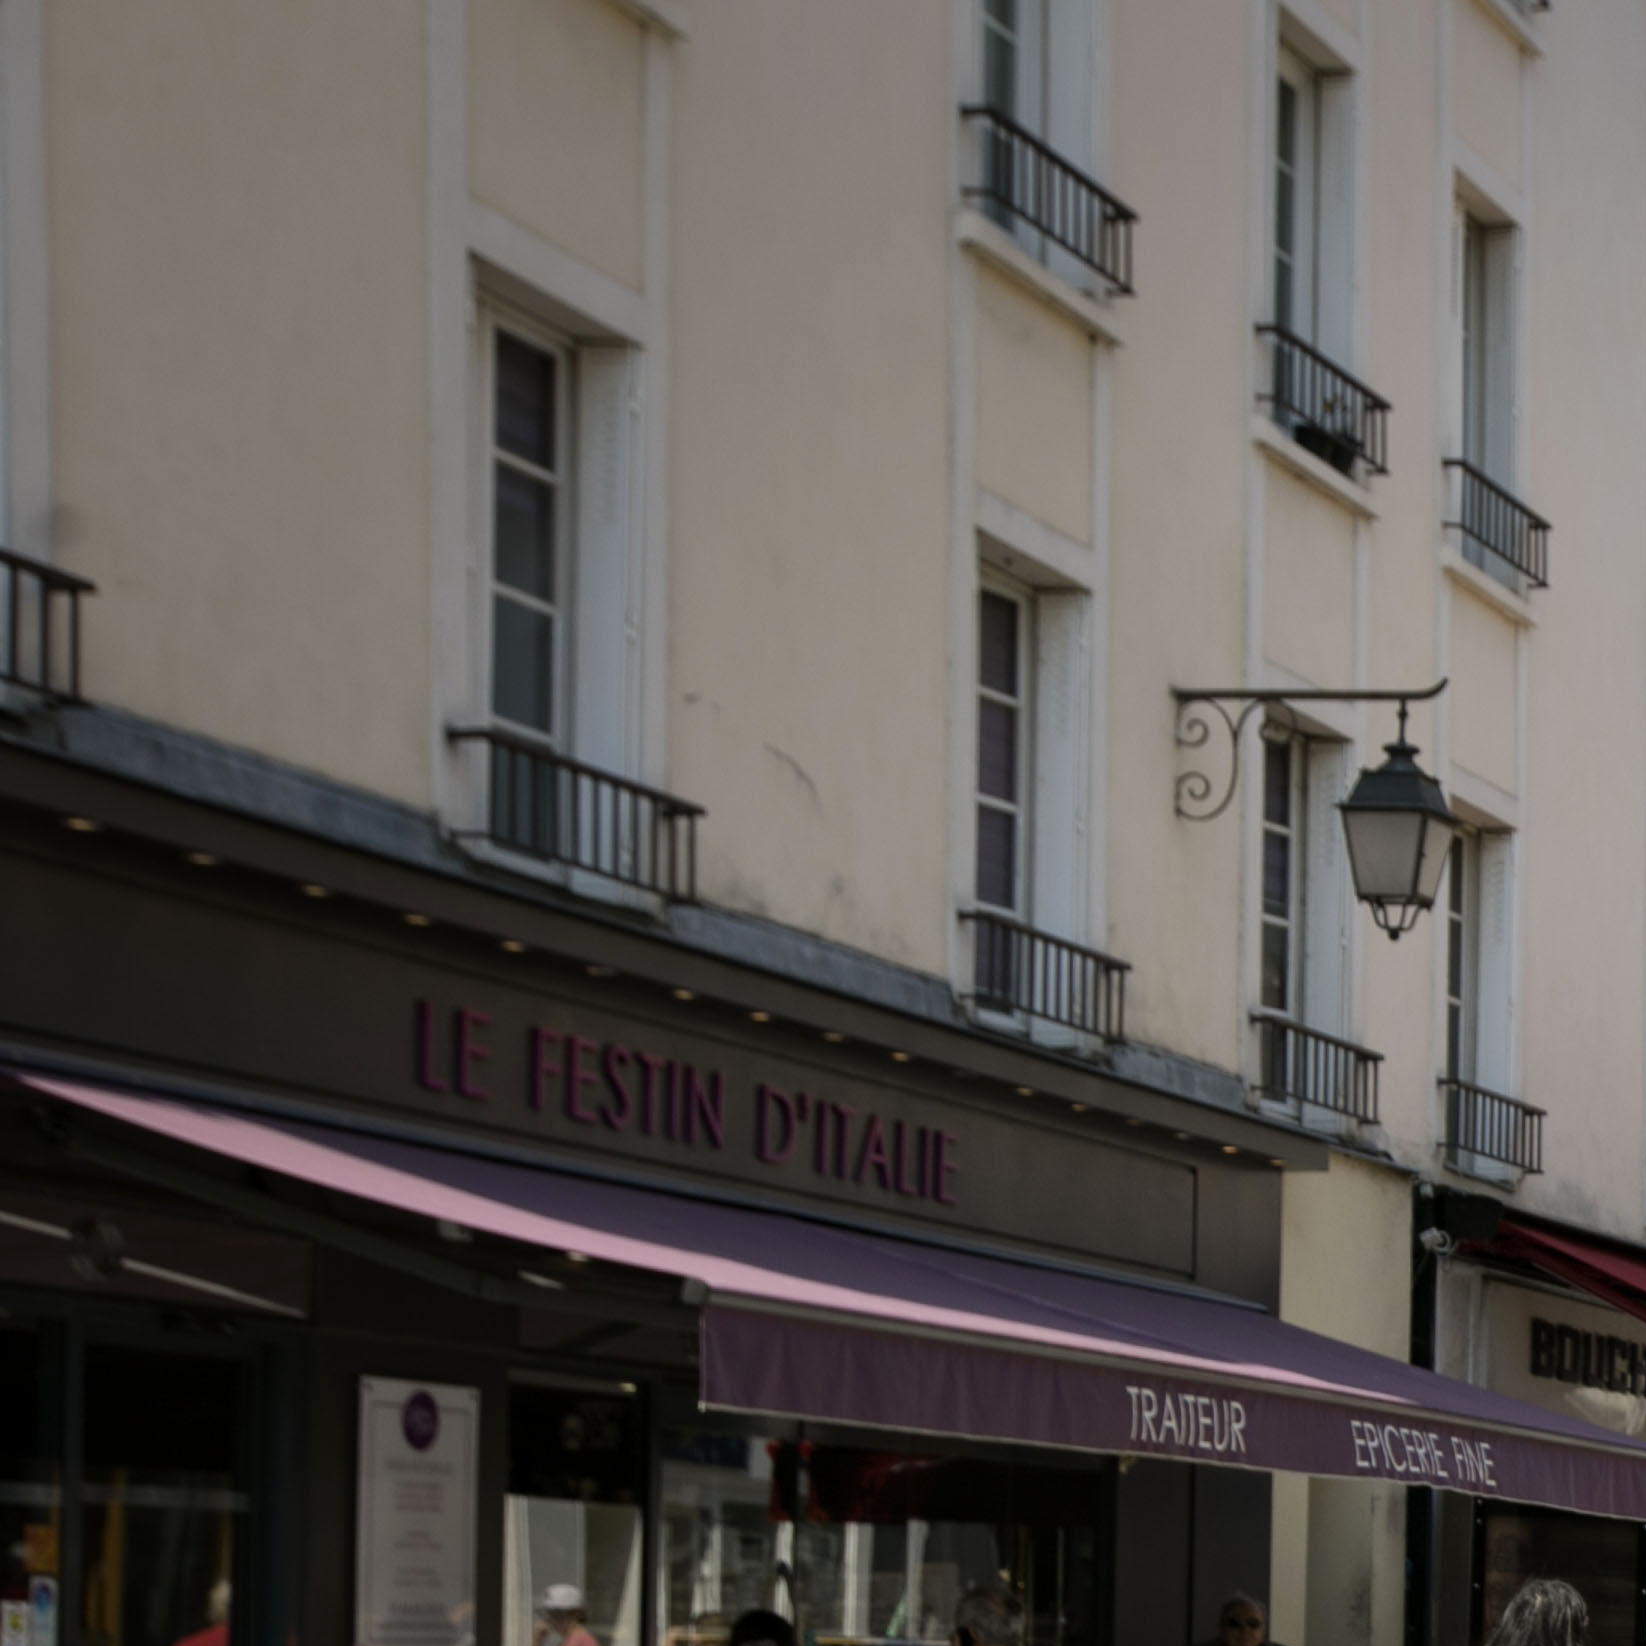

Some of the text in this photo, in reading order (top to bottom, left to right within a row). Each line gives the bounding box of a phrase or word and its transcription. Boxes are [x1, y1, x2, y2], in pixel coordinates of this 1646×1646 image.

[417, 1000, 960, 1206] LE FESTIN D'ITALIE
[1126, 1386, 1497, 1486] TRAITEUR EPICERIE FINE
